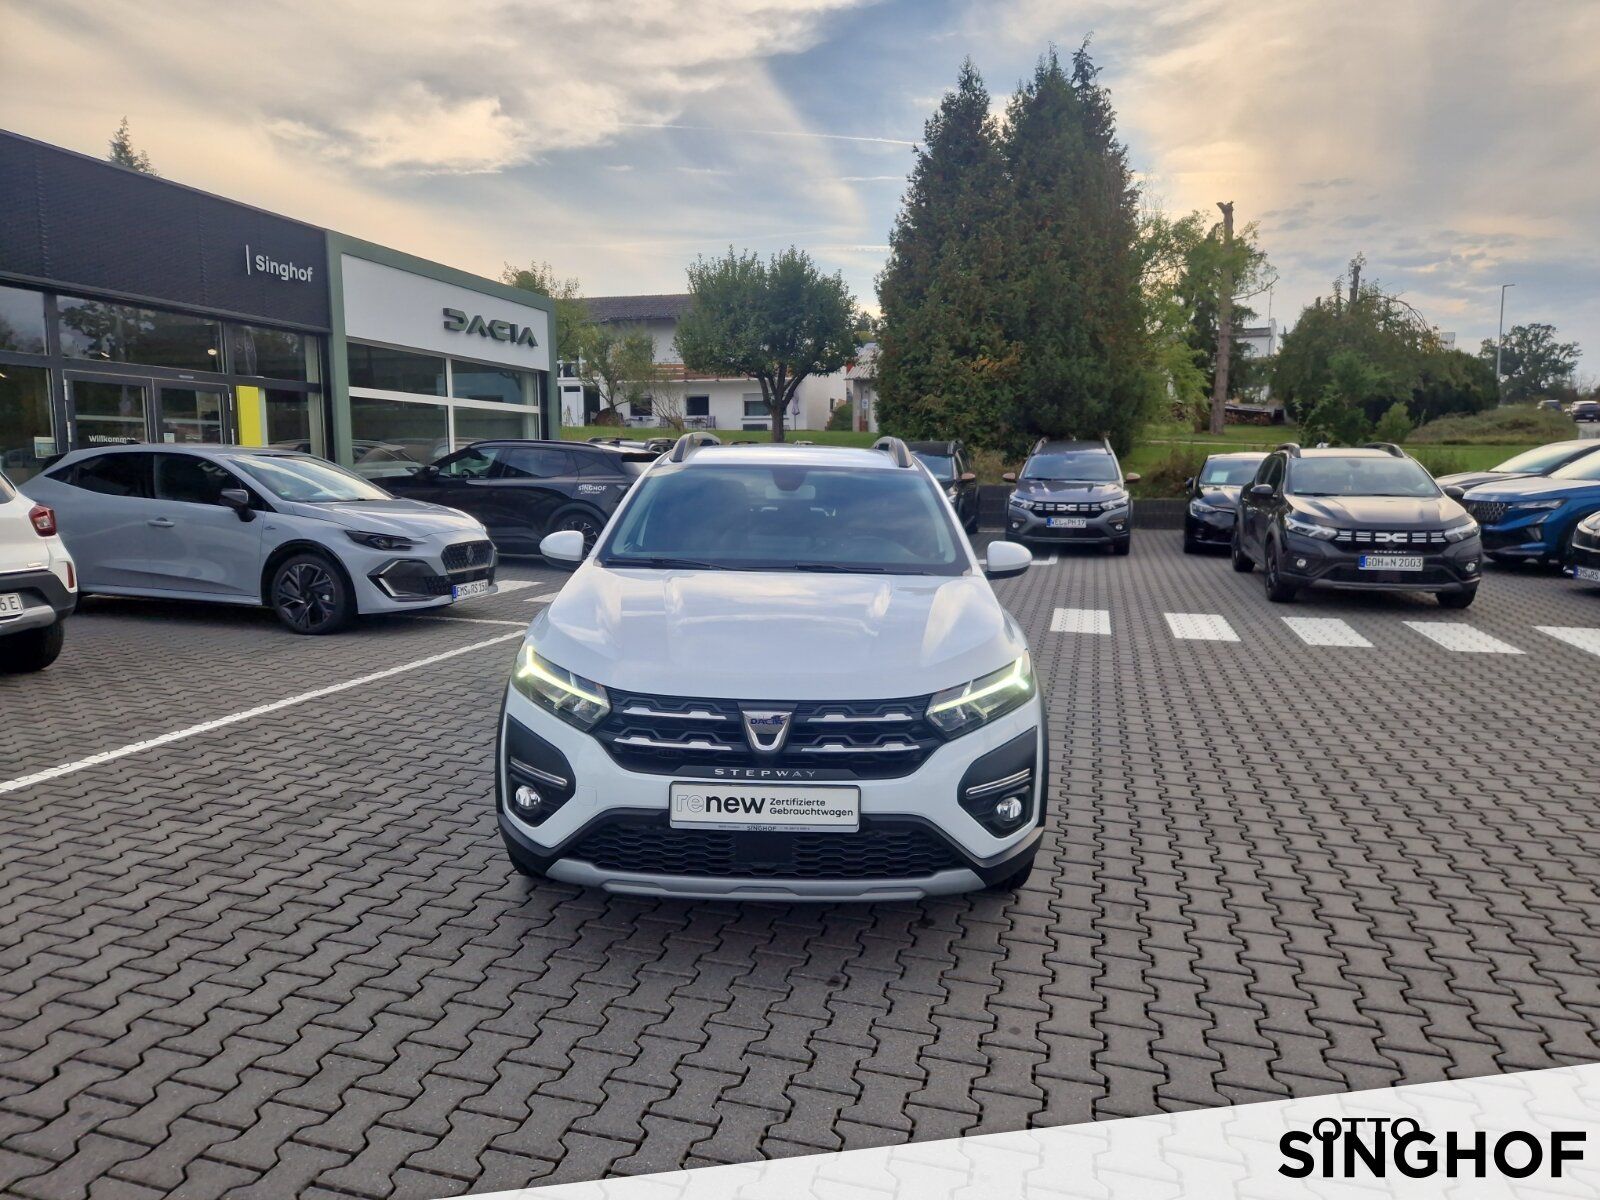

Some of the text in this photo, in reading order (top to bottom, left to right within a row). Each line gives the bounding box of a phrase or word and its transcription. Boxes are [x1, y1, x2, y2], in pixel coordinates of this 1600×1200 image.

[255, 255, 313, 282] Singhof
[443, 307, 538, 348] DACIA
[1366, 558, 1422, 568] GOH N 2003
[714, 768, 816, 777] STEPWAY
[676, 794, 766, 814] renew
[770, 798, 826, 806] Zertifizierte
[770, 807, 853, 818] Gebrauchtwagen
